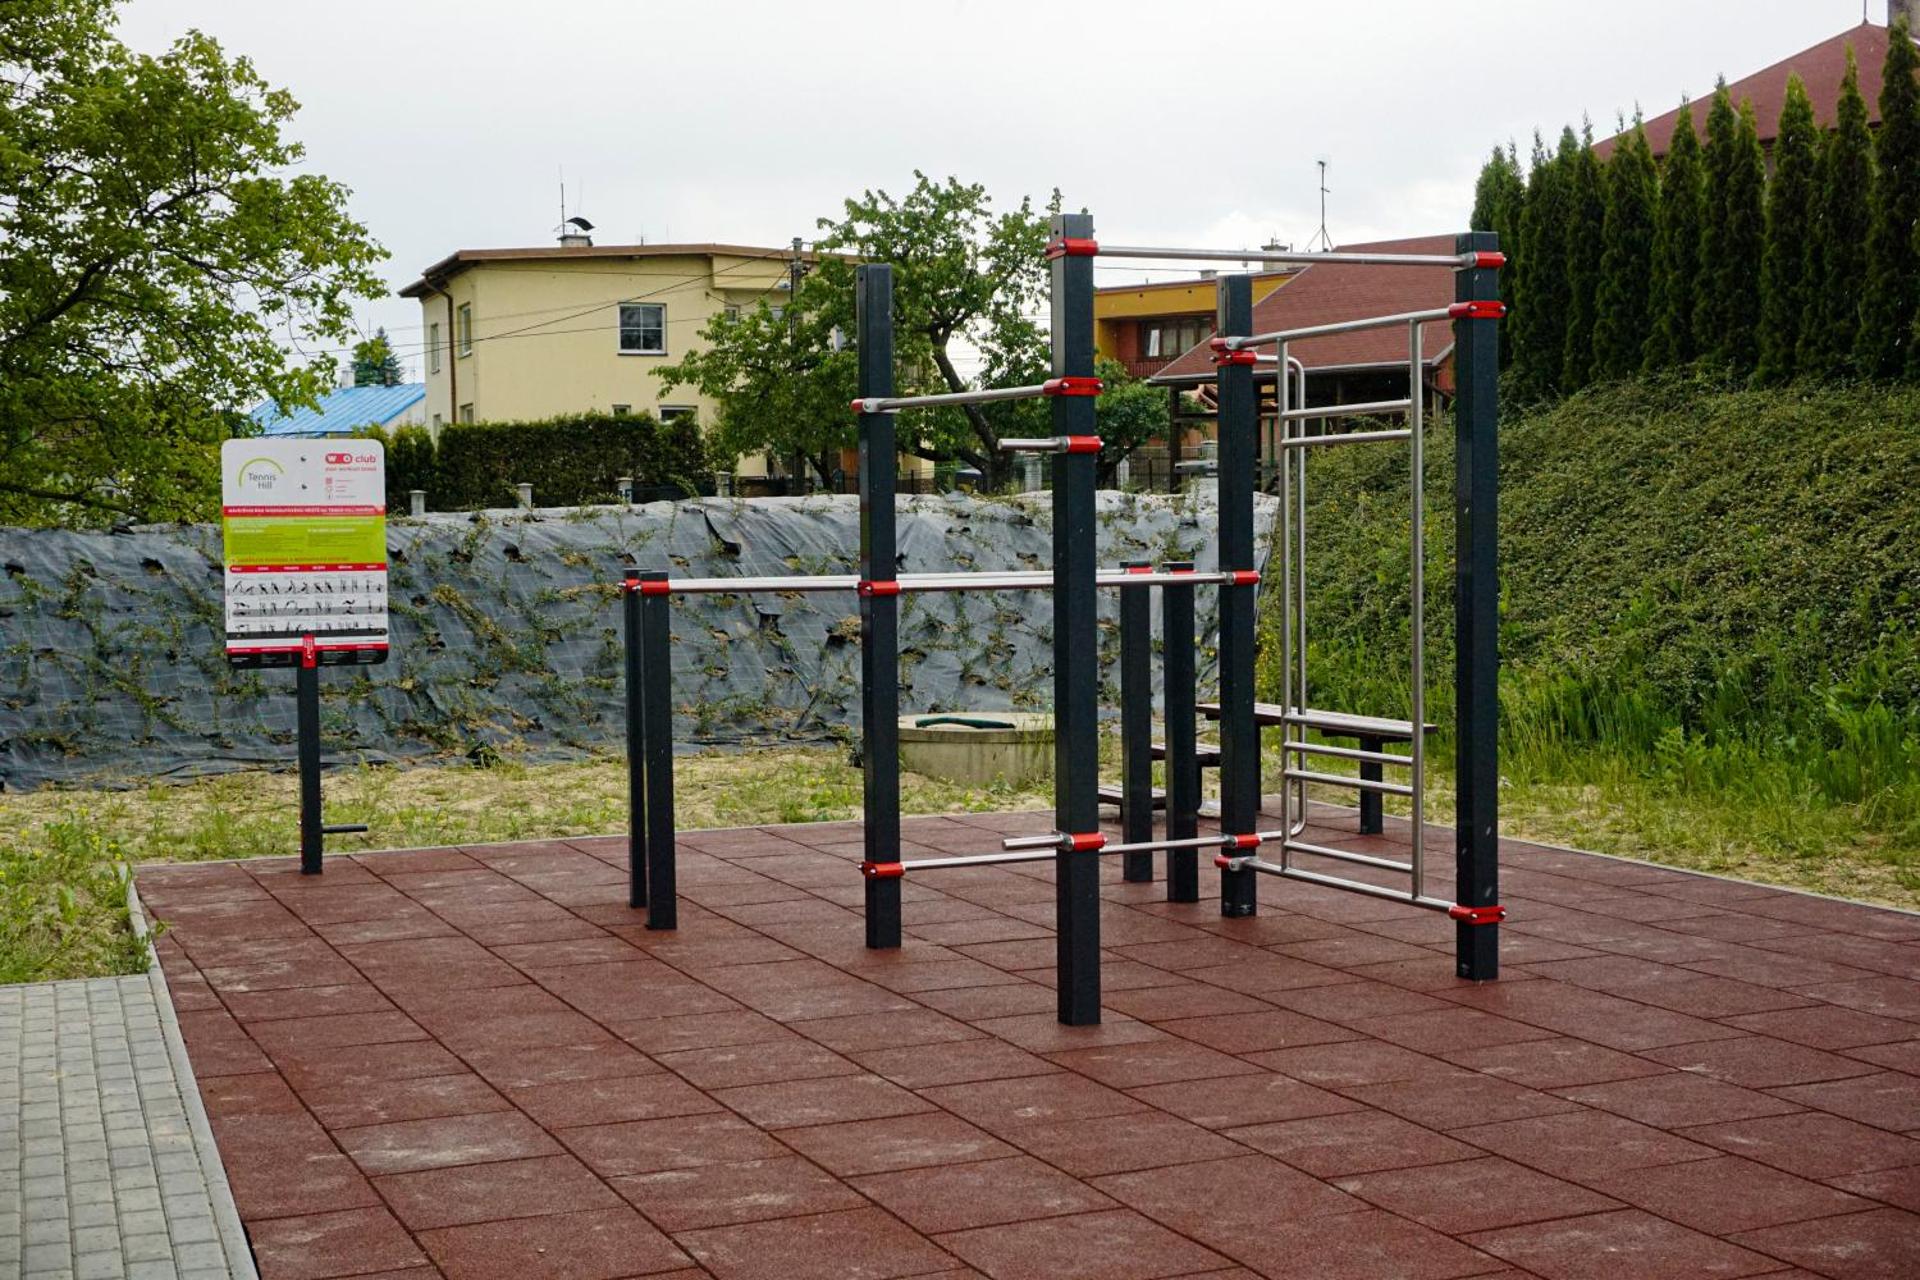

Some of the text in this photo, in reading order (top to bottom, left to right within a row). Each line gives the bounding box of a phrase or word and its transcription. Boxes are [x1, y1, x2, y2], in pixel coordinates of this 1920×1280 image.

[355, 455, 376, 463] club
[248, 472, 277, 481] Tennis
[257, 480, 272, 489] Hill
